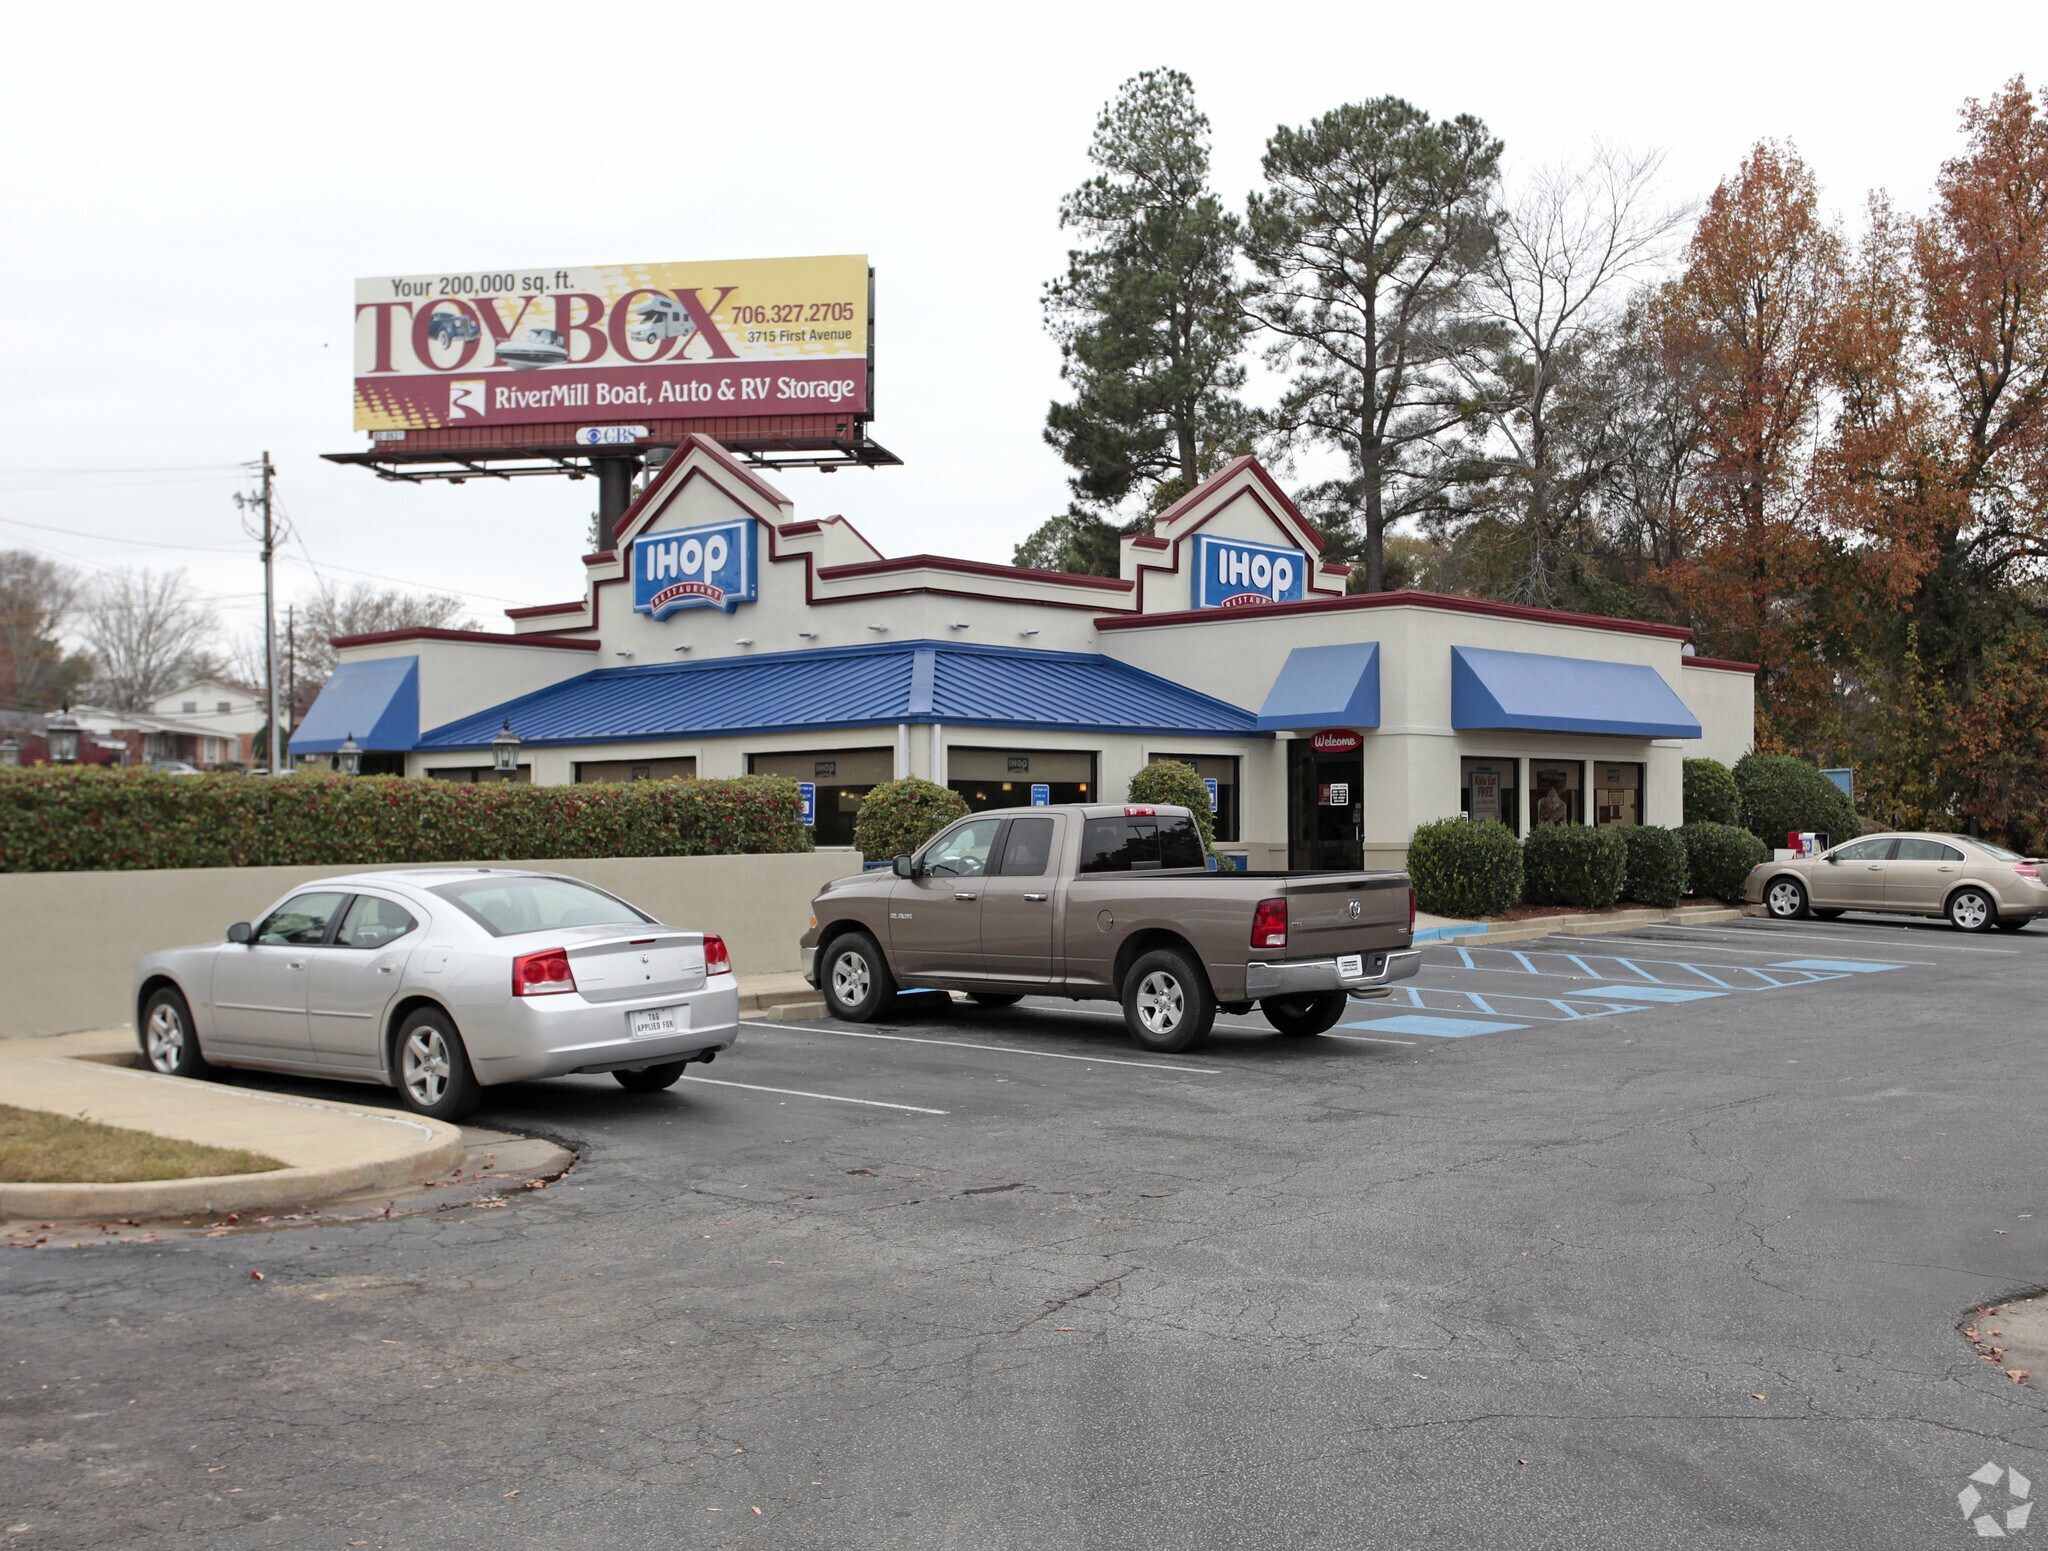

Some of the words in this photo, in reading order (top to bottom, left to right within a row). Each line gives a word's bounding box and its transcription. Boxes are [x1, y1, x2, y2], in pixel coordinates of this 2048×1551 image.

[391, 279, 433, 297] Your
[439, 273, 515, 295] 200,000
[521, 275, 550, 294] sq.
[554, 270, 574, 289] ft.
[731, 302, 854, 324] 706.327.2705
[748, 330, 776, 343] 3715
[780, 329, 805, 342] First
[809, 329, 852, 341] Avenue
[495, 383, 589, 409] RiverMill
[596, 381, 653, 406] Boat,
[658, 380, 712, 403] Auto
[717, 378, 736, 400] &
[741, 377, 771, 400] RV
[777, 376, 855, 403] Storage
[604, 427, 637, 444] CBS
[646, 534, 728, 586] IHOP
[1218, 548, 1293, 603] IHOP
[653, 584, 720, 606] RESTAURANT
[1225, 595, 1273, 607] RESTAUR
[1315, 733, 1356, 747] Welcome
[1477, 786, 1494, 797] FREE
[890, 912, 913, 920] RAM
[648, 1012, 660, 1021] TAG
[637, 1021, 661, 1032] APPLIED
[662, 1020, 674, 1029] FOR
